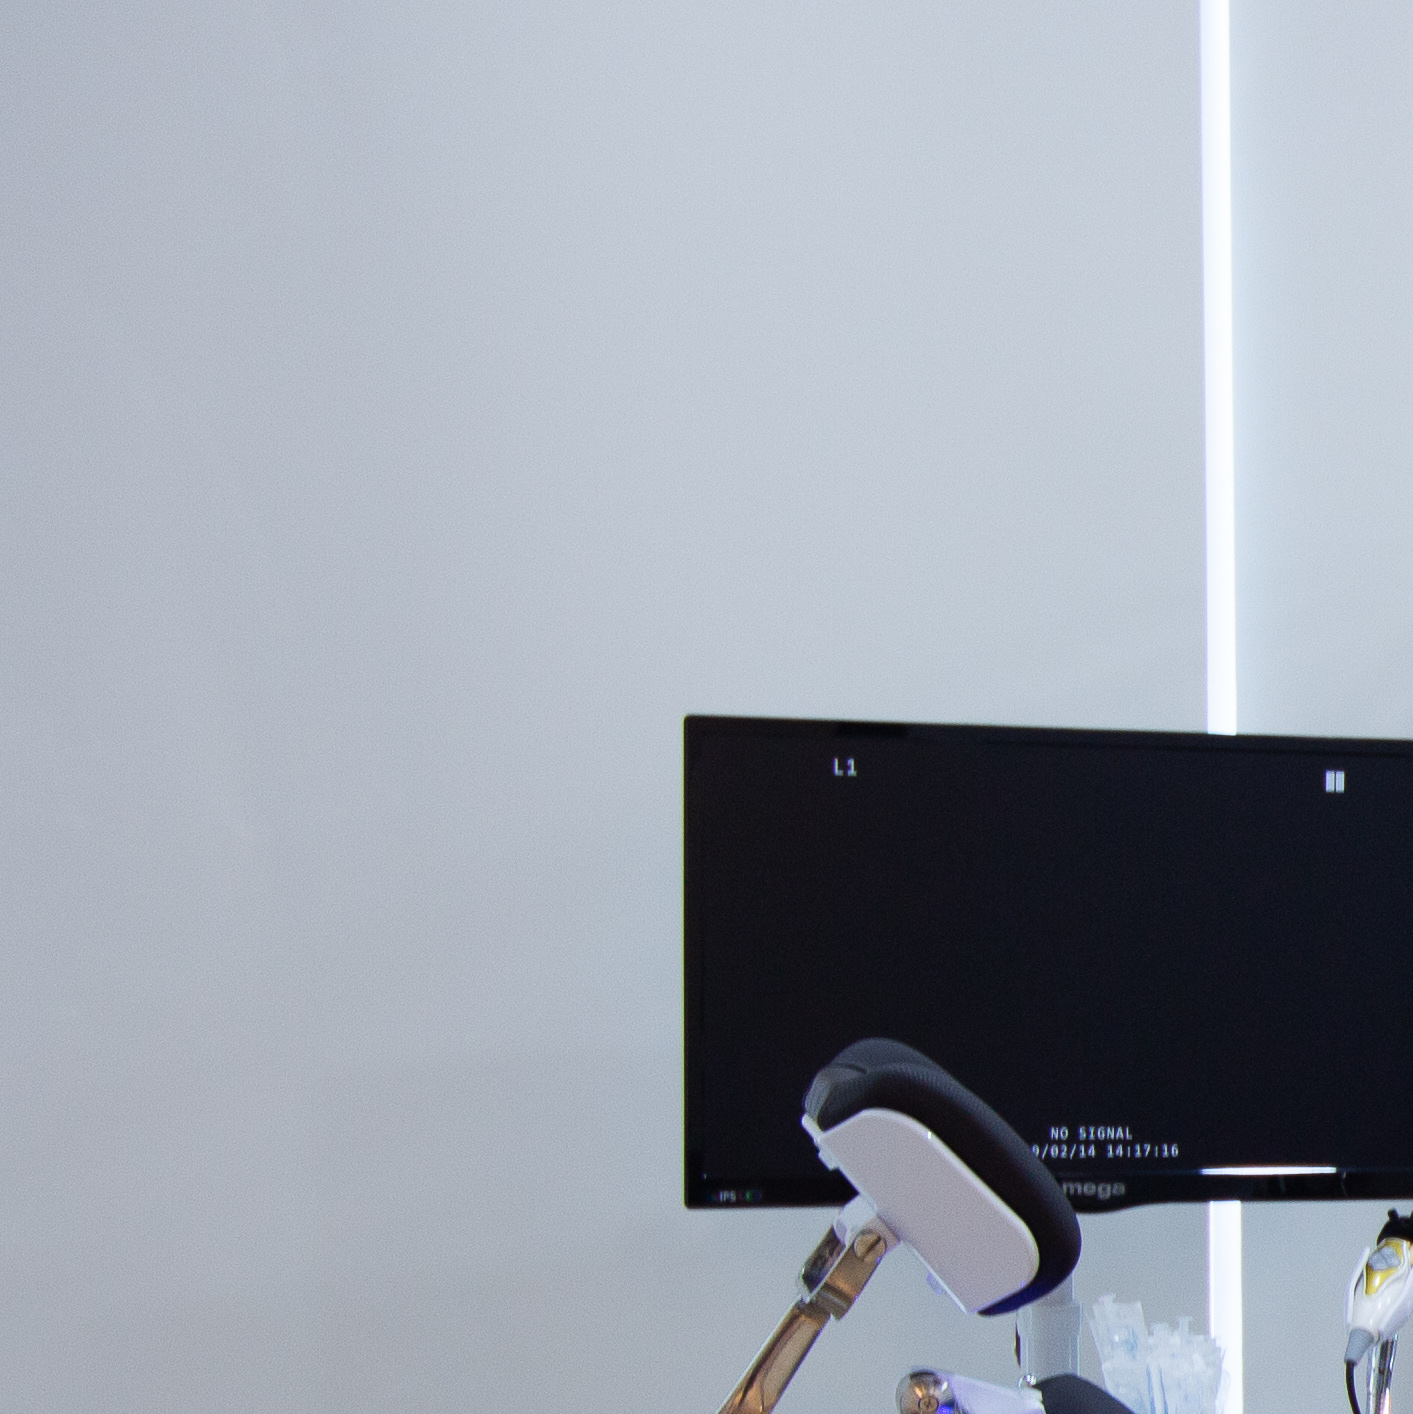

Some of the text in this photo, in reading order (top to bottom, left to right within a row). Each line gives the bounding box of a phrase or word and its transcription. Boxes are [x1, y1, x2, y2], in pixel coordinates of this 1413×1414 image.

[832, 757, 857, 777] L1
[1051, 1126, 1133, 1140] NO SIGNAL
[1106, 1143, 1179, 1158] 14:17:16
